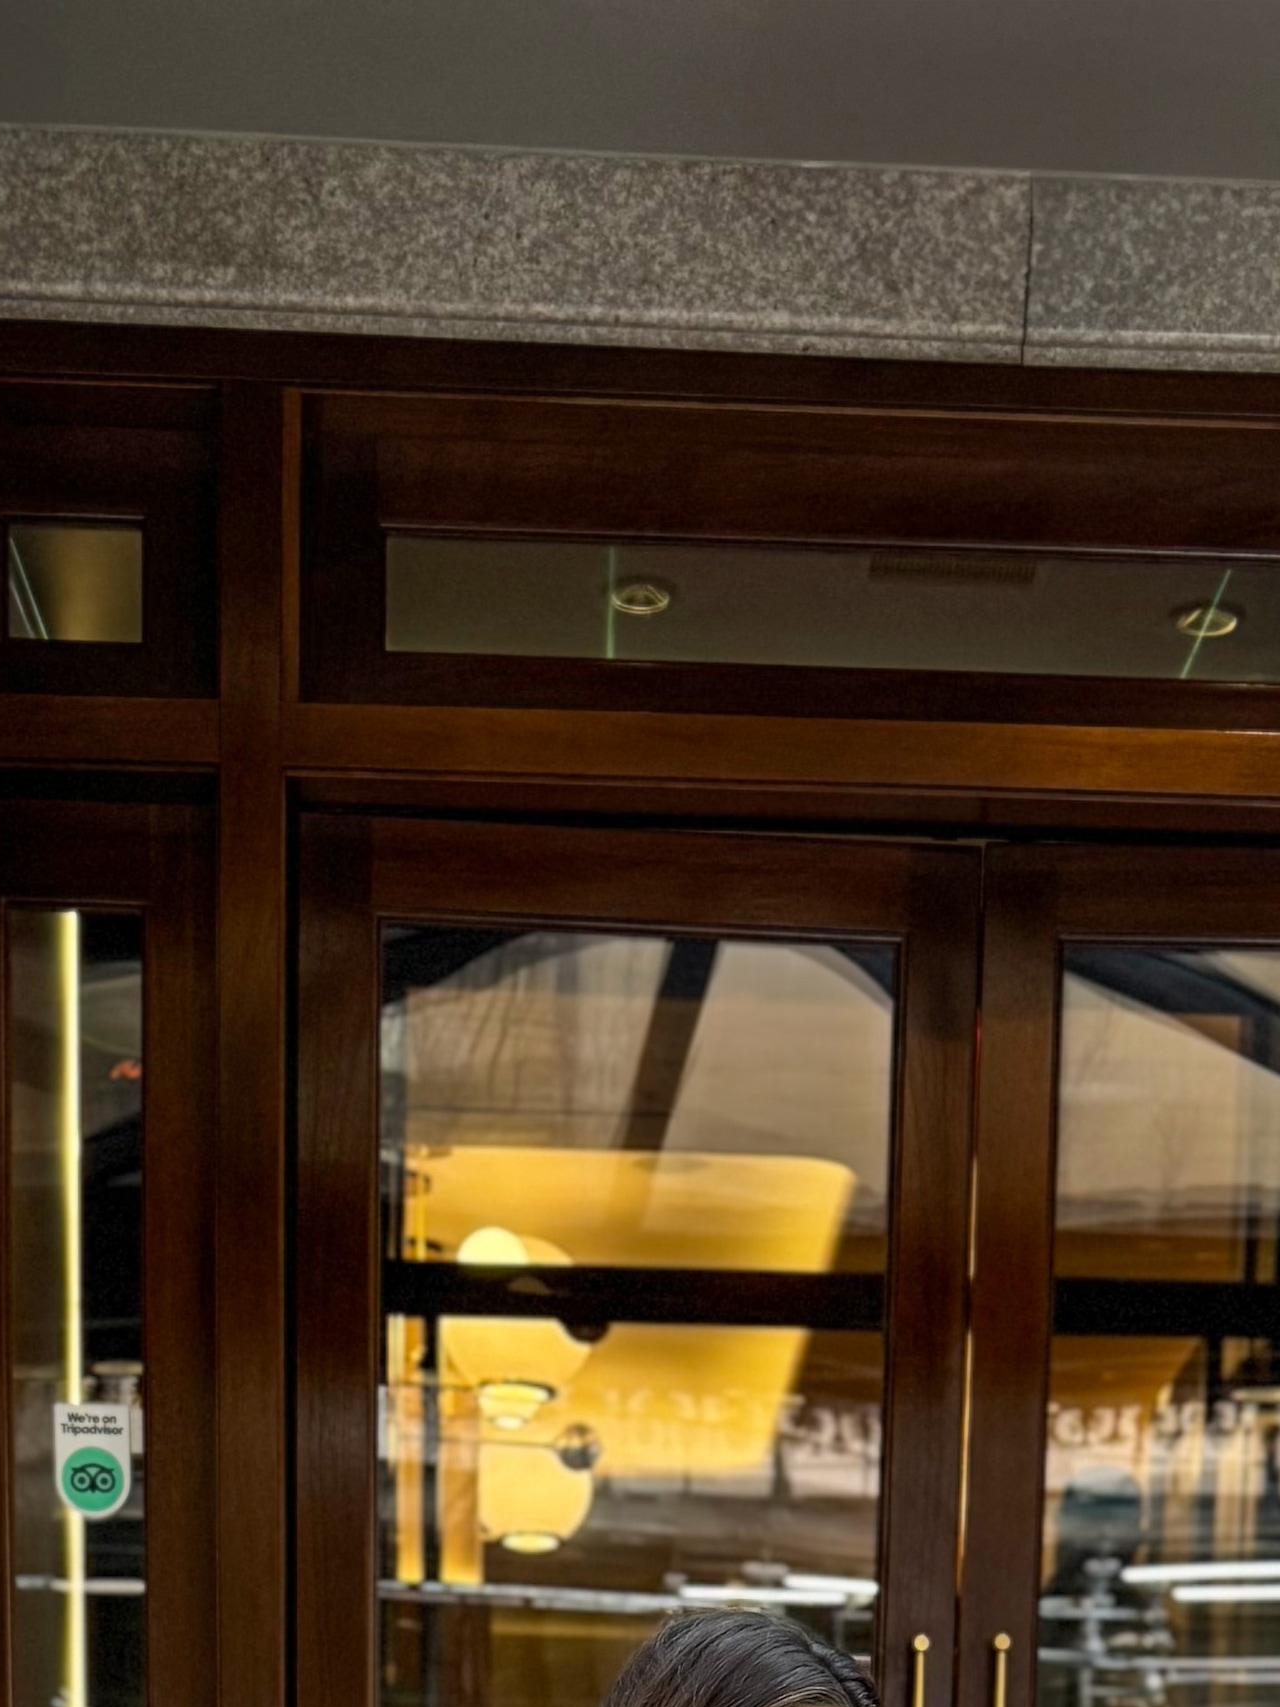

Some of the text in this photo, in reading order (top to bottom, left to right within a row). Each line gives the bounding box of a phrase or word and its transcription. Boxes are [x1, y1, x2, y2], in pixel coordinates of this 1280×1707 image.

[67, 1412, 117, 1425] We're on
[61, 1424, 123, 1436] Tripadvisor
